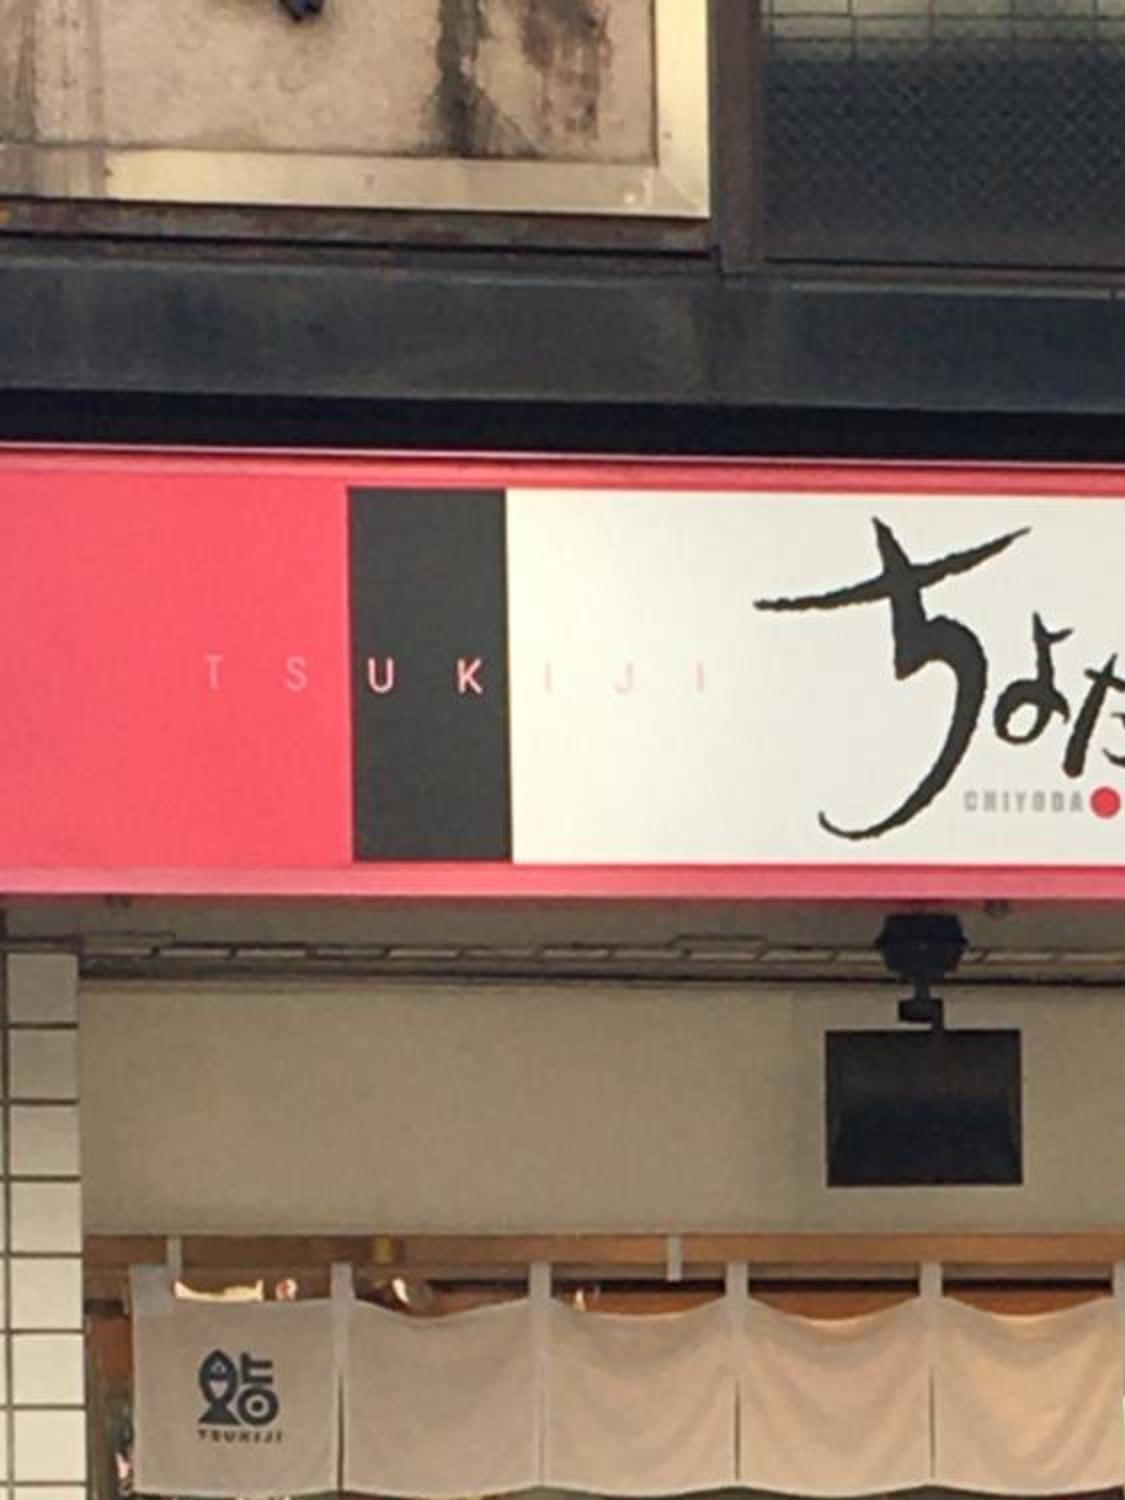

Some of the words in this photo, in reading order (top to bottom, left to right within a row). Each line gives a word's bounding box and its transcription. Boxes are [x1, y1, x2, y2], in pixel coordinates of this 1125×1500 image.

[204, 655, 705, 694] TSUKIJI
[963, 790, 1084, 812] CHIYODA
[198, 1428, 282, 1442] TSUKIJI
